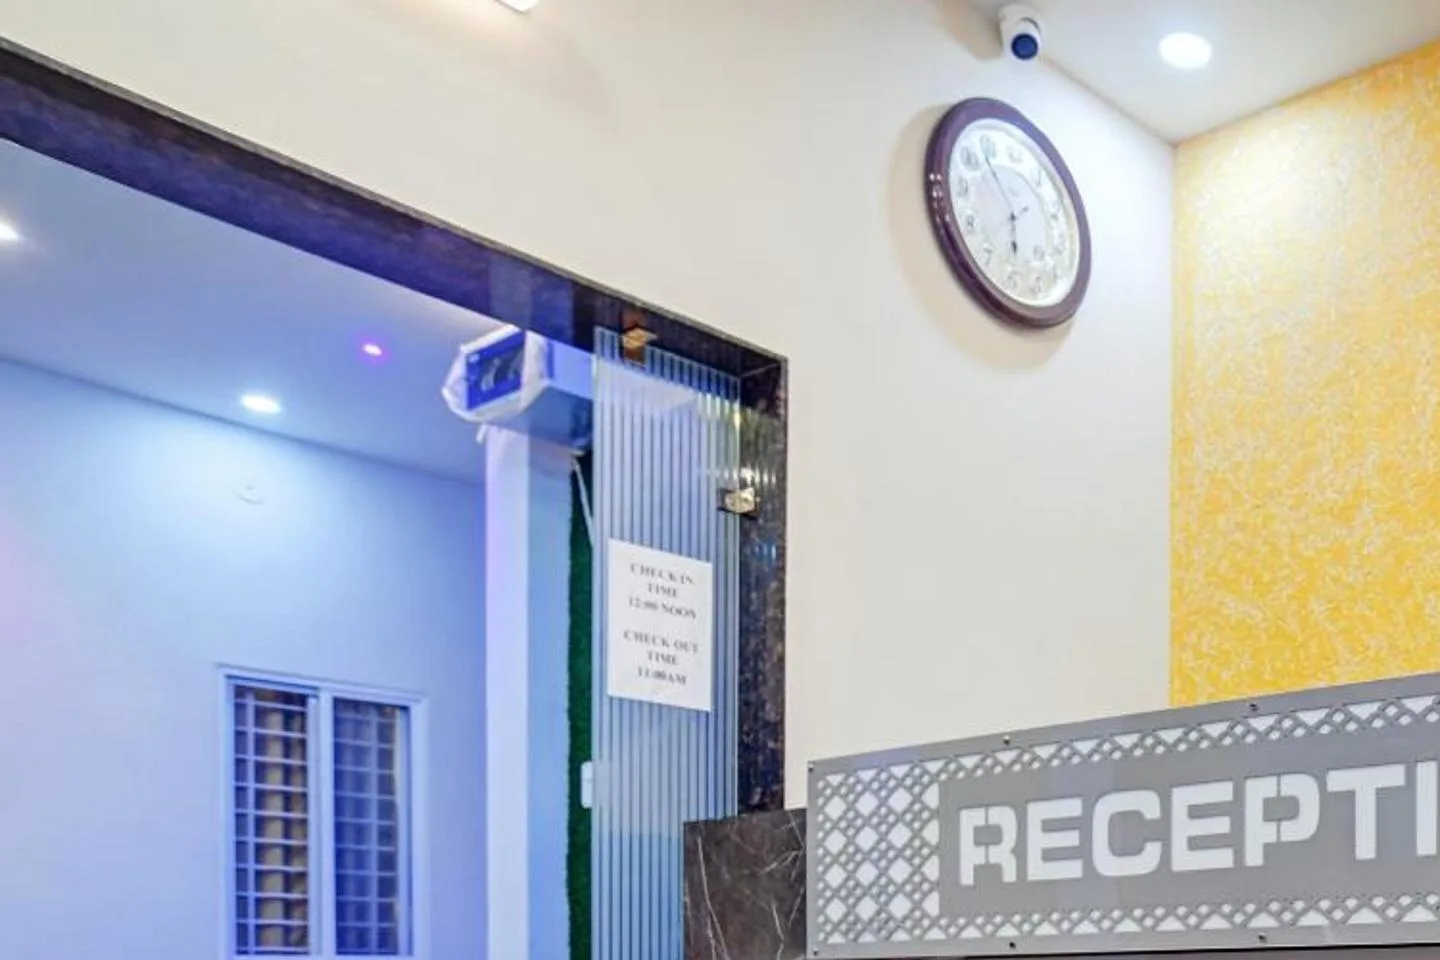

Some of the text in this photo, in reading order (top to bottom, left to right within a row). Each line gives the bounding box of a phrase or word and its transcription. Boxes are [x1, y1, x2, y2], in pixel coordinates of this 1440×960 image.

[630, 563, 694, 585] CHECK IN
[648, 583, 678, 597] TIME
[661, 603, 697, 619] NOON
[623, 630, 699, 653] CHECK OUT
[647, 652, 678, 665] TIME
